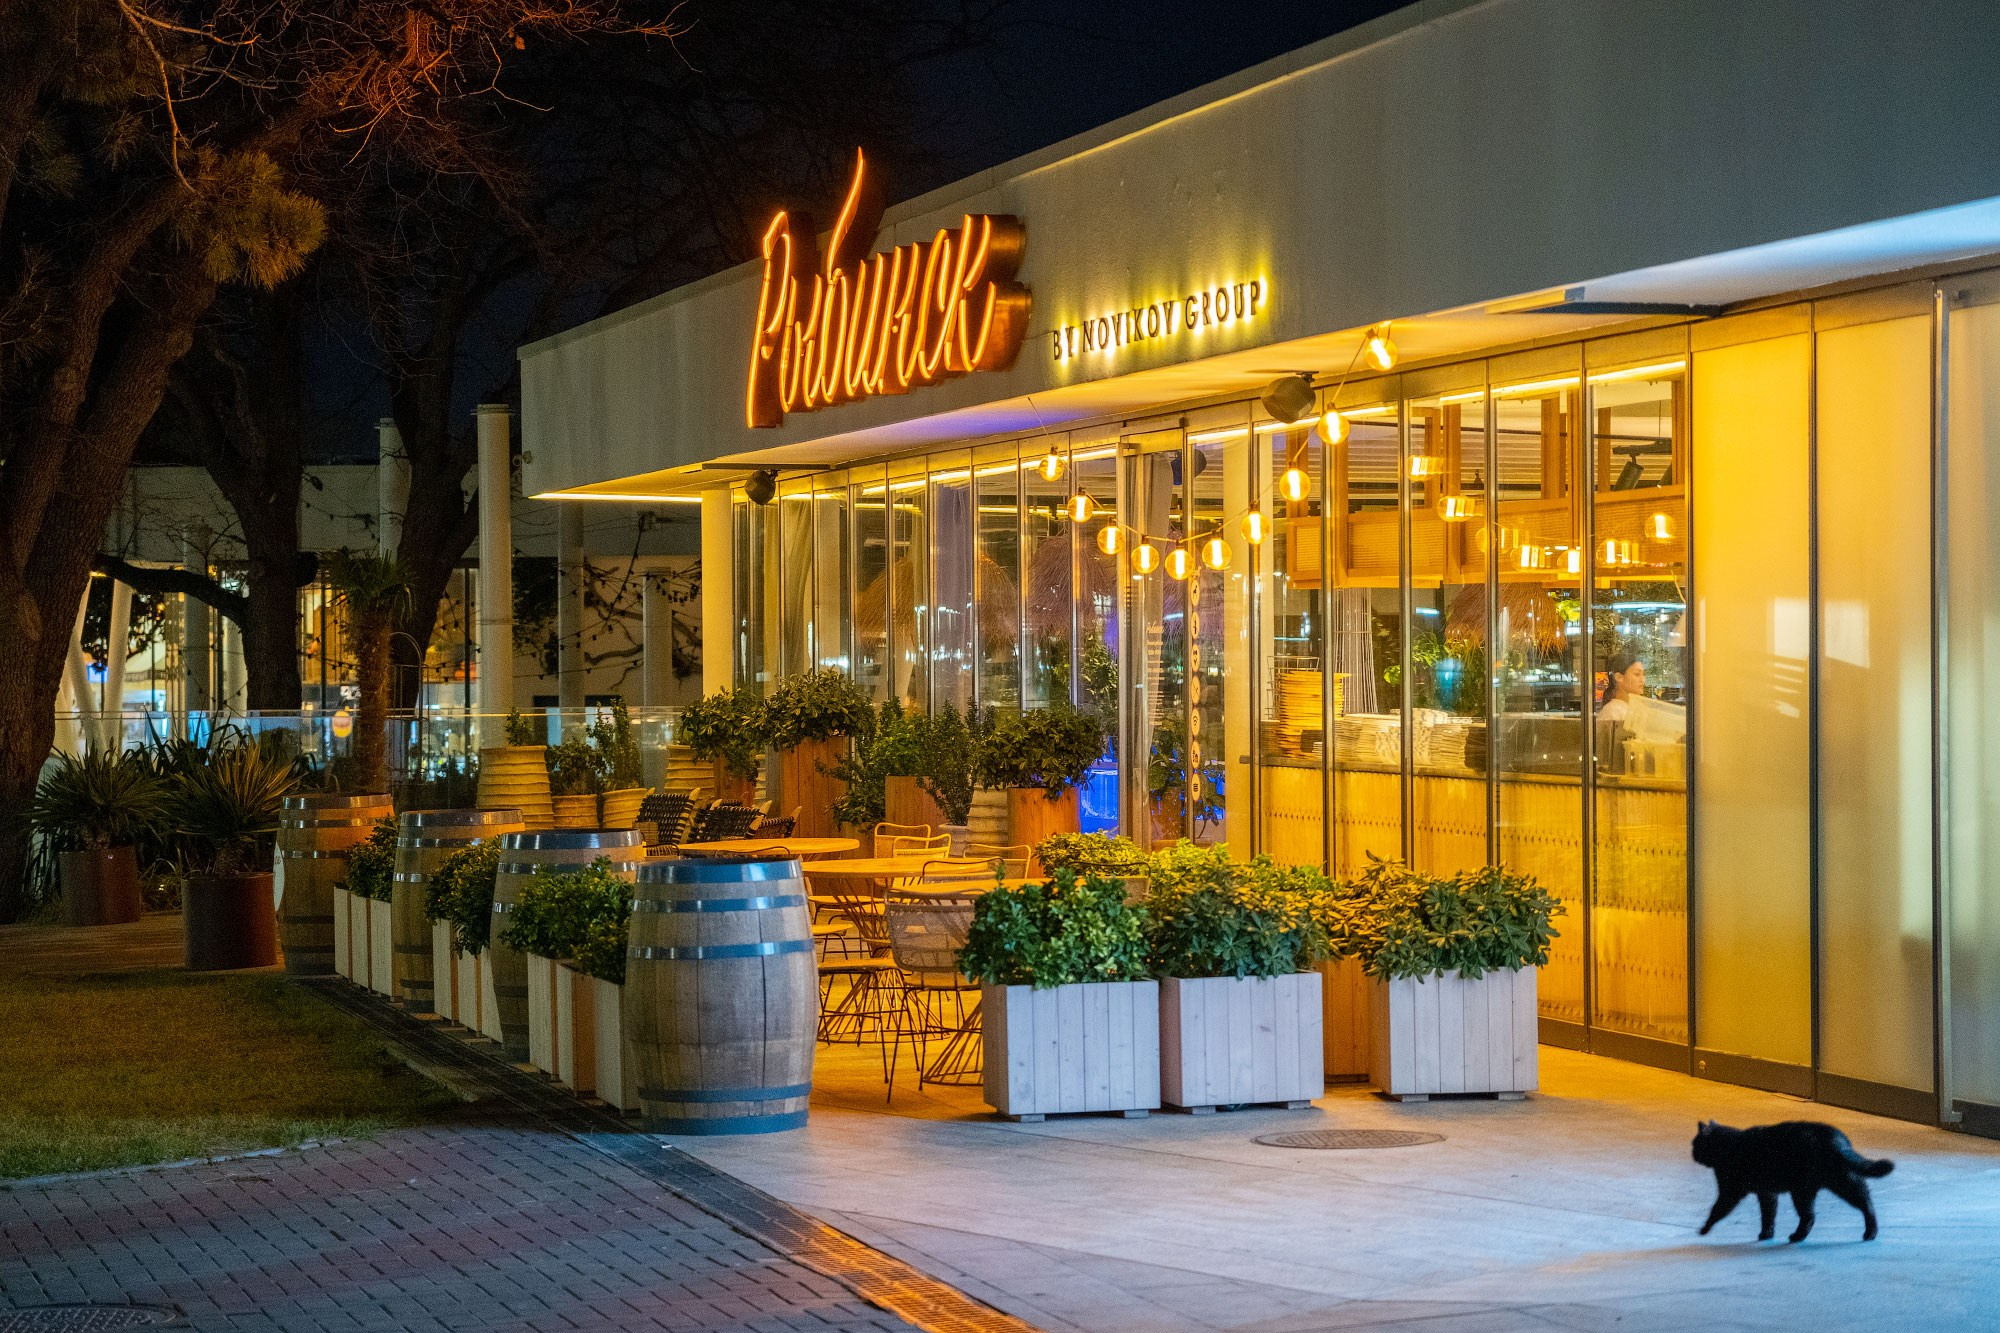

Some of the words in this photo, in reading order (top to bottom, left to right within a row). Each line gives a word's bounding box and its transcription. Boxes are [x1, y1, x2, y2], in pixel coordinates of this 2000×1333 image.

[1053, 325, 1075, 361] BY
[1082, 299, 1175, 353] NOVIKOV
[1185, 280, 1261, 330] GROUP
